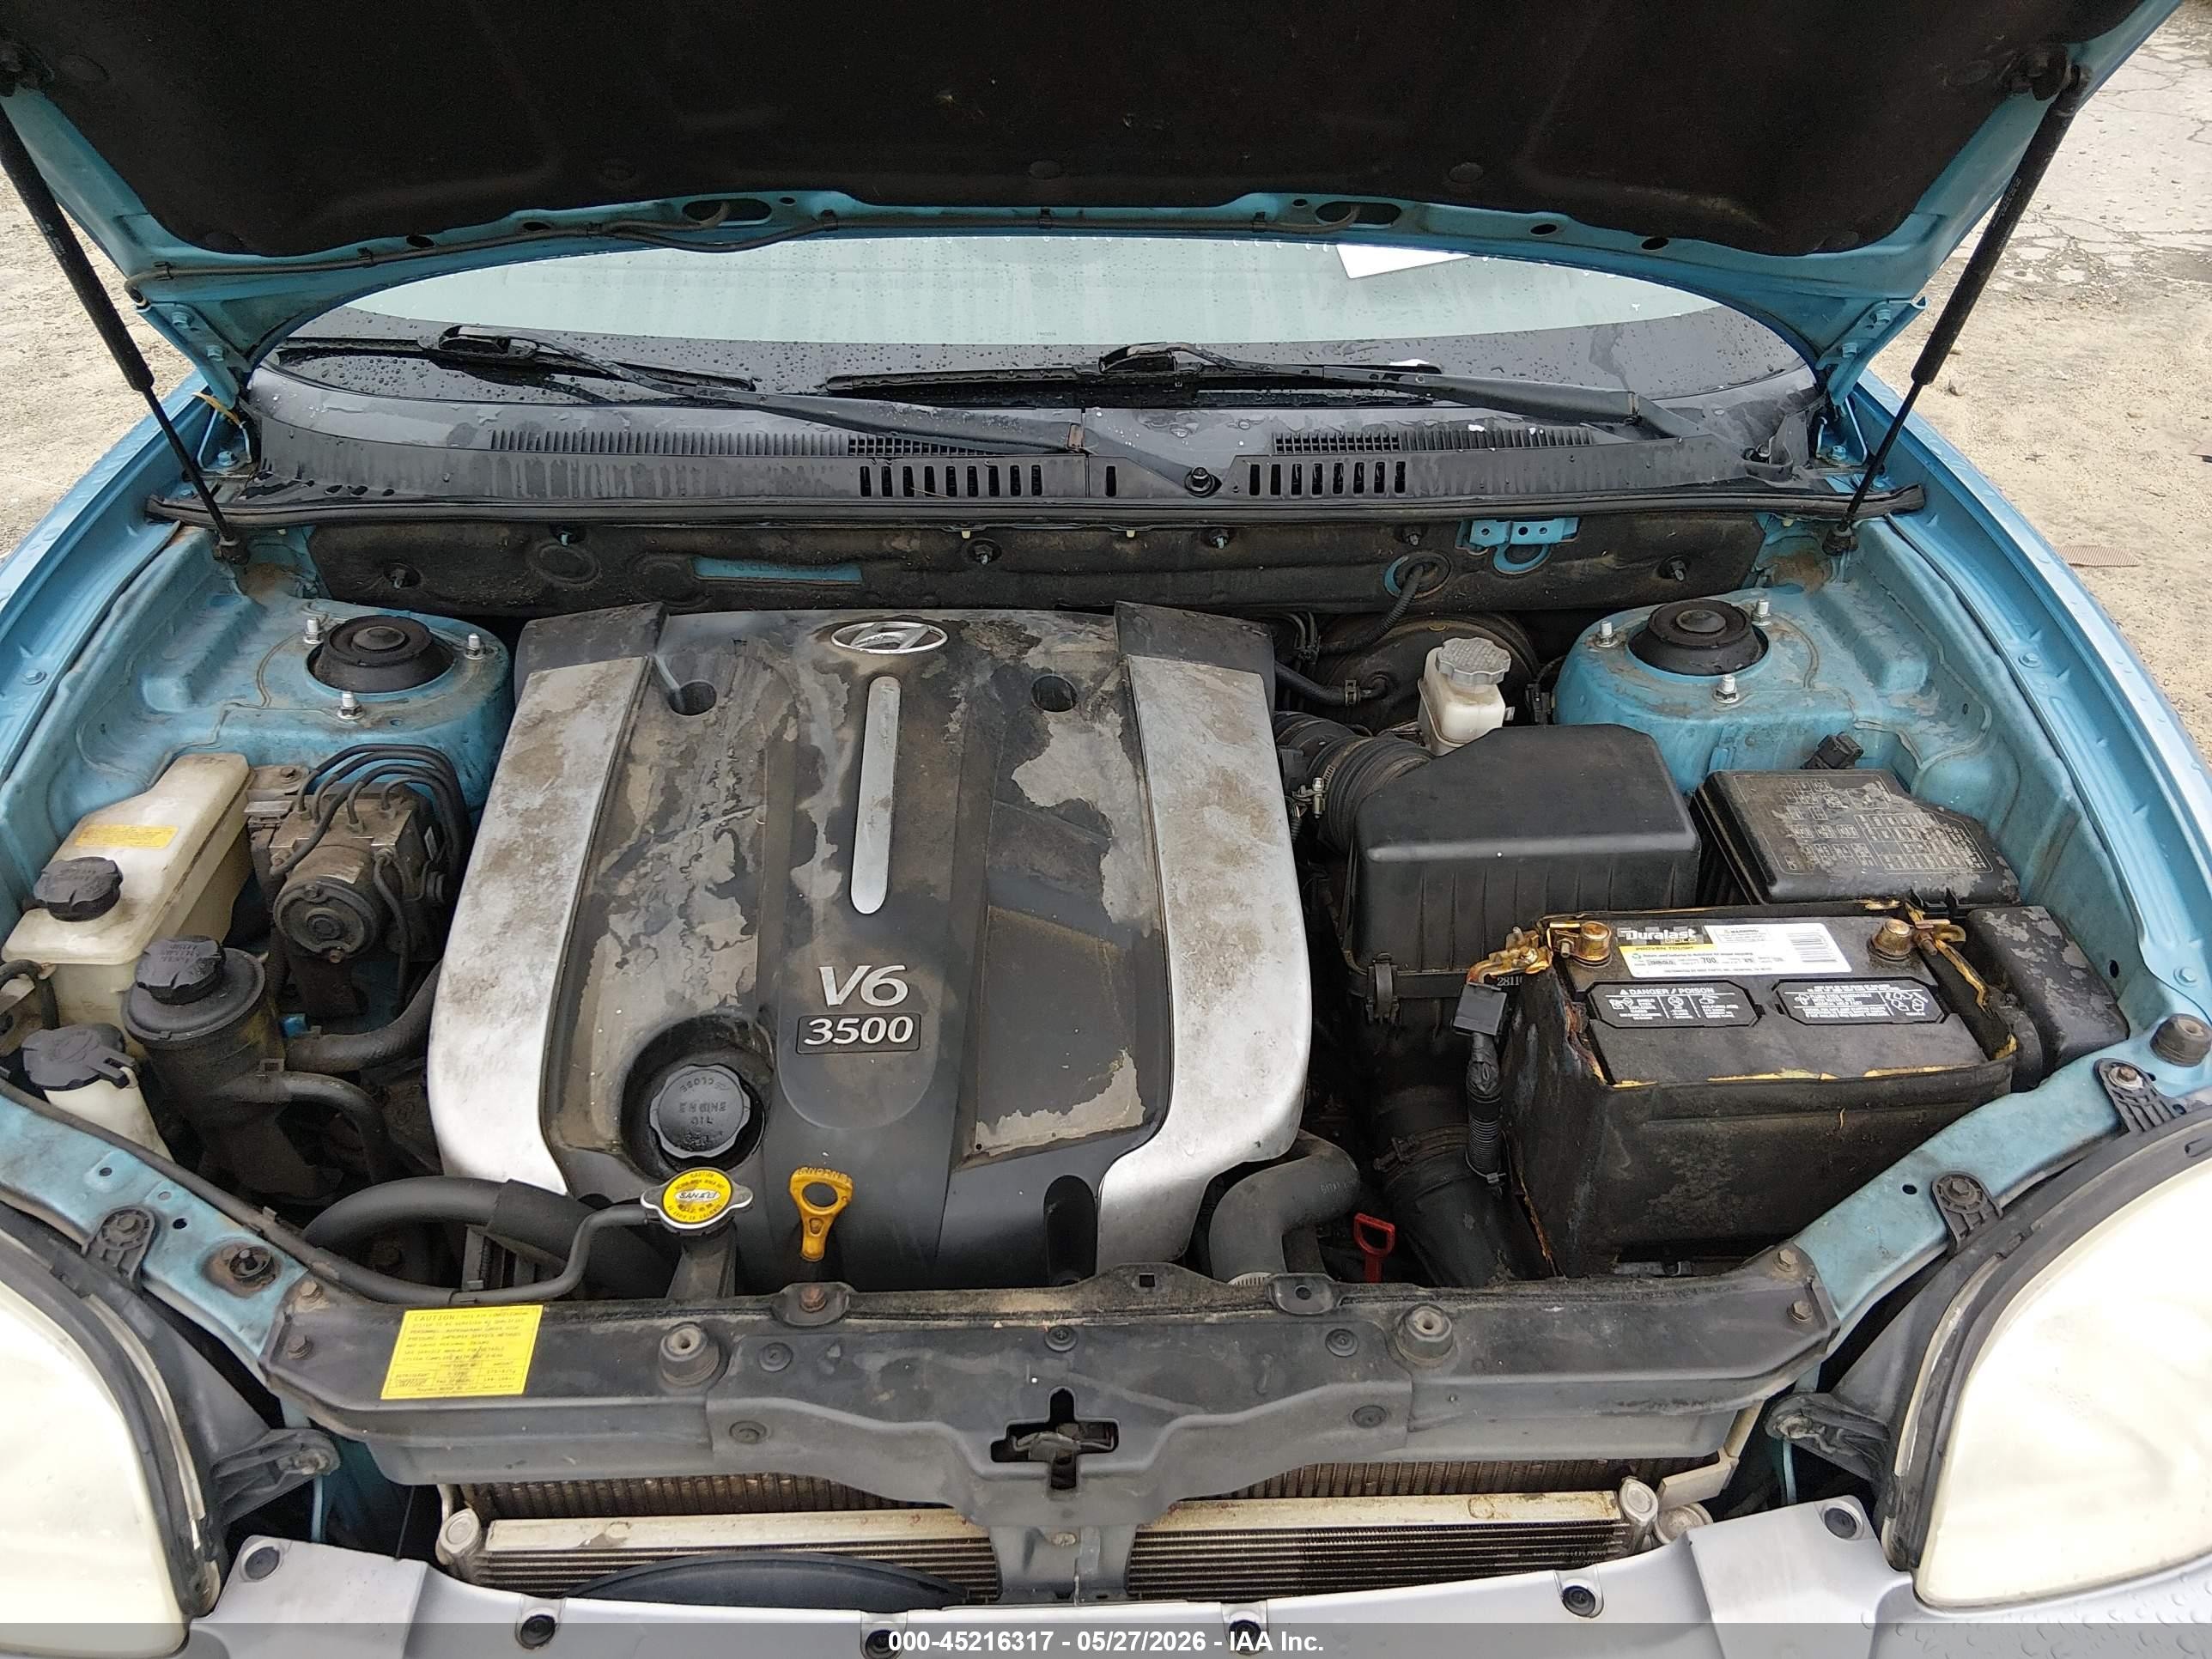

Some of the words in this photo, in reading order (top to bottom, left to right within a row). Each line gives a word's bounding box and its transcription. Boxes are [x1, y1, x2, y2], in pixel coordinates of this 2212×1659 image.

[1620, 928, 1697, 940] Duralast
[818, 965, 909, 1007] V6
[803, 1016, 914, 1045] 3500
[679, 1102, 726, 1114] ENGINE
[690, 1116, 713, 1126] OIL
